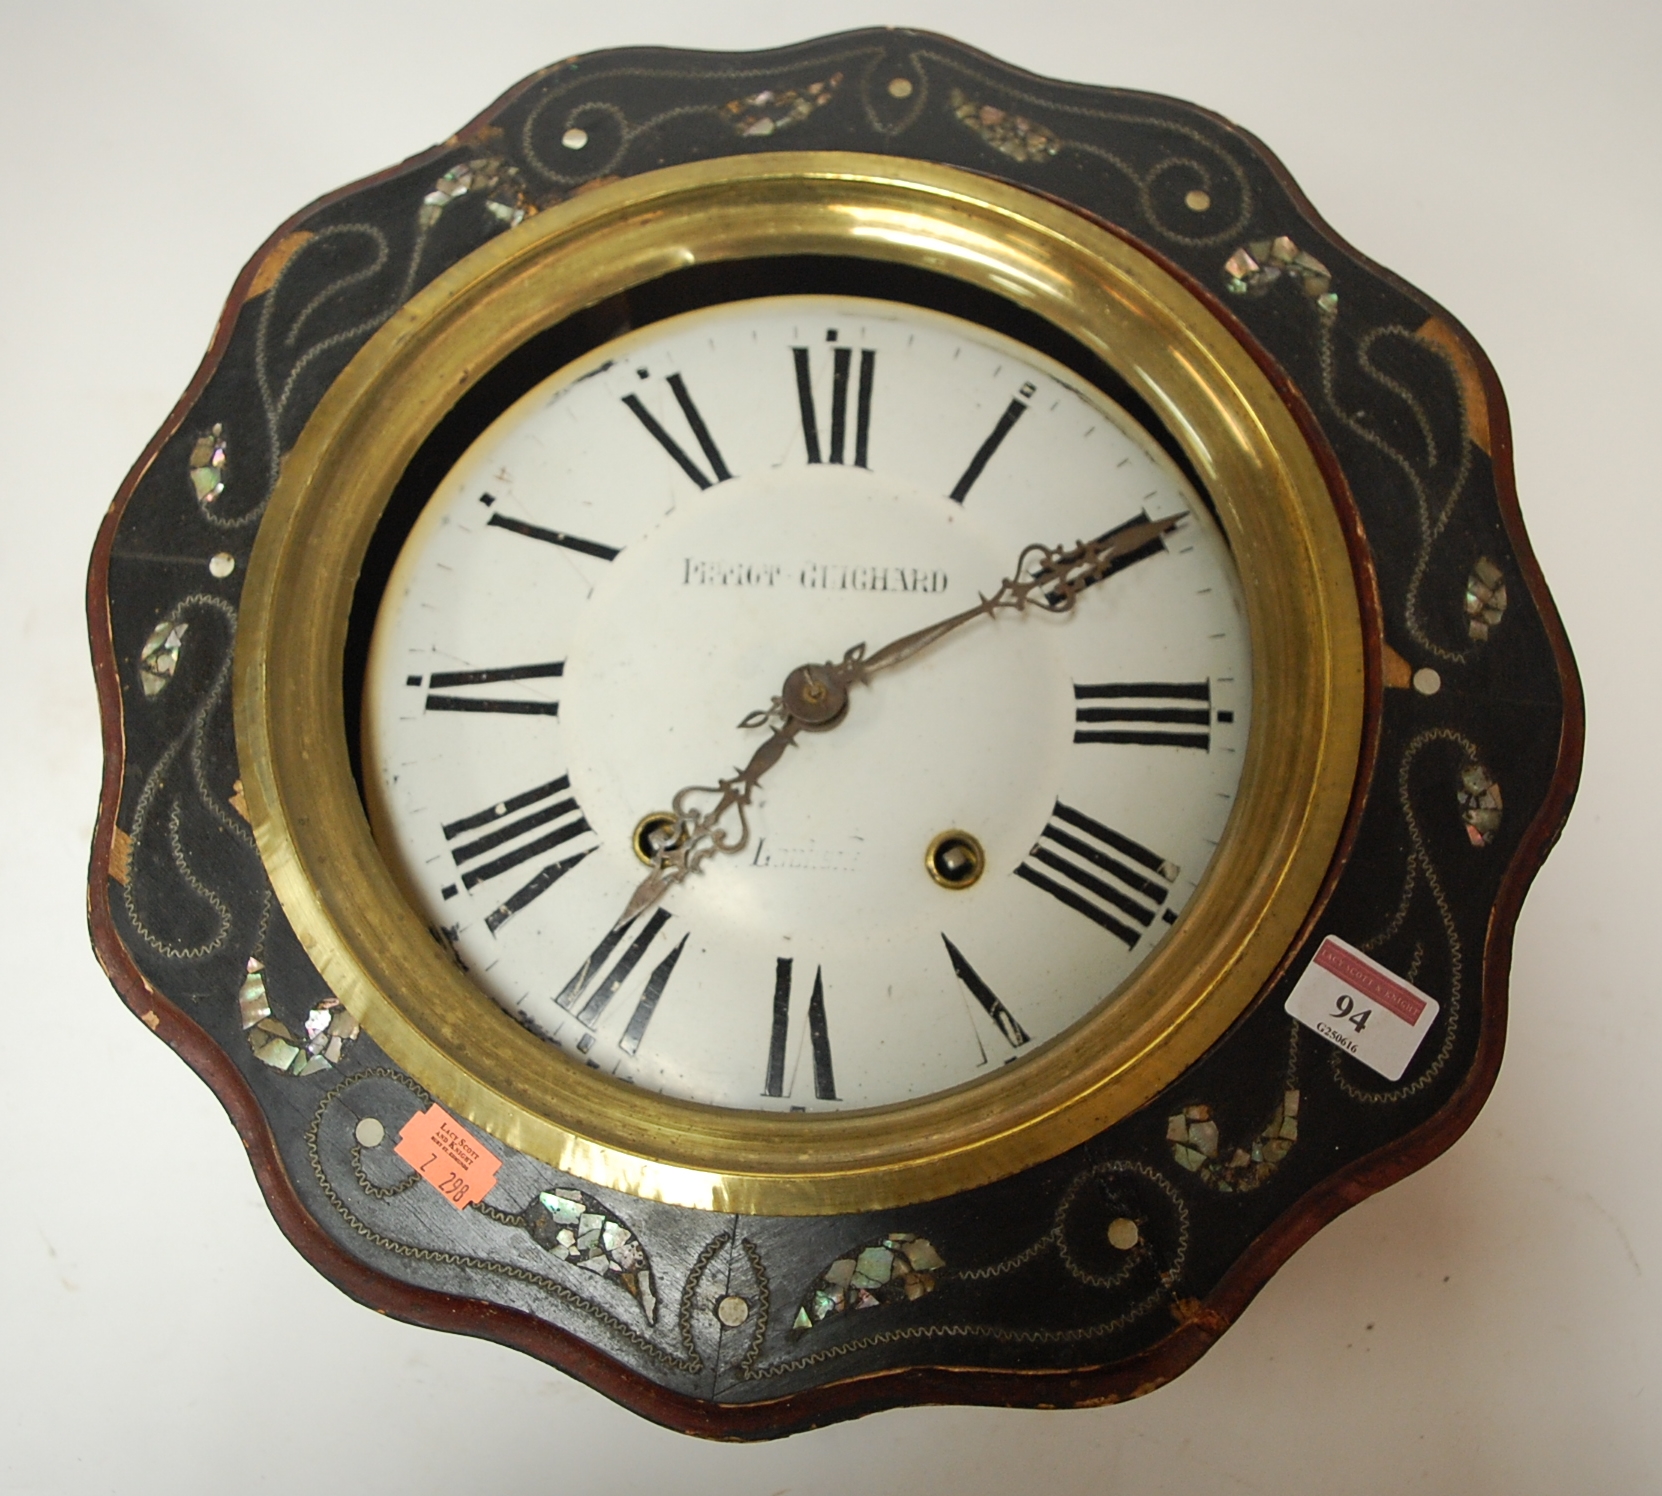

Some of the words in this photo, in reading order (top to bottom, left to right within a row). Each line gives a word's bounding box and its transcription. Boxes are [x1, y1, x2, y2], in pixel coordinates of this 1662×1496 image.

[949, 396, 1028, 505] I
[1073, 677, 1211, 753] III
[442, 769, 600, 938] VIII
[1013, 796, 1181, 951] IIII
[553, 907, 690, 1056] VII
[1321, 949, 1344, 967] LACY
[1344, 964, 1374, 986] SCOTT
[1384, 990, 1419, 1016] KNIGHT
[1329, 994, 1373, 1034] 94
[1316, 1021, 1359, 1054] G250616
[435, 1130, 449, 1143] AND
[448, 1141, 474, 1165] KNIGHT
[440, 1122, 460, 1140] LACY
[457, 1138, 481, 1160] SCOTT
[438, 1171, 470, 1202] 298
